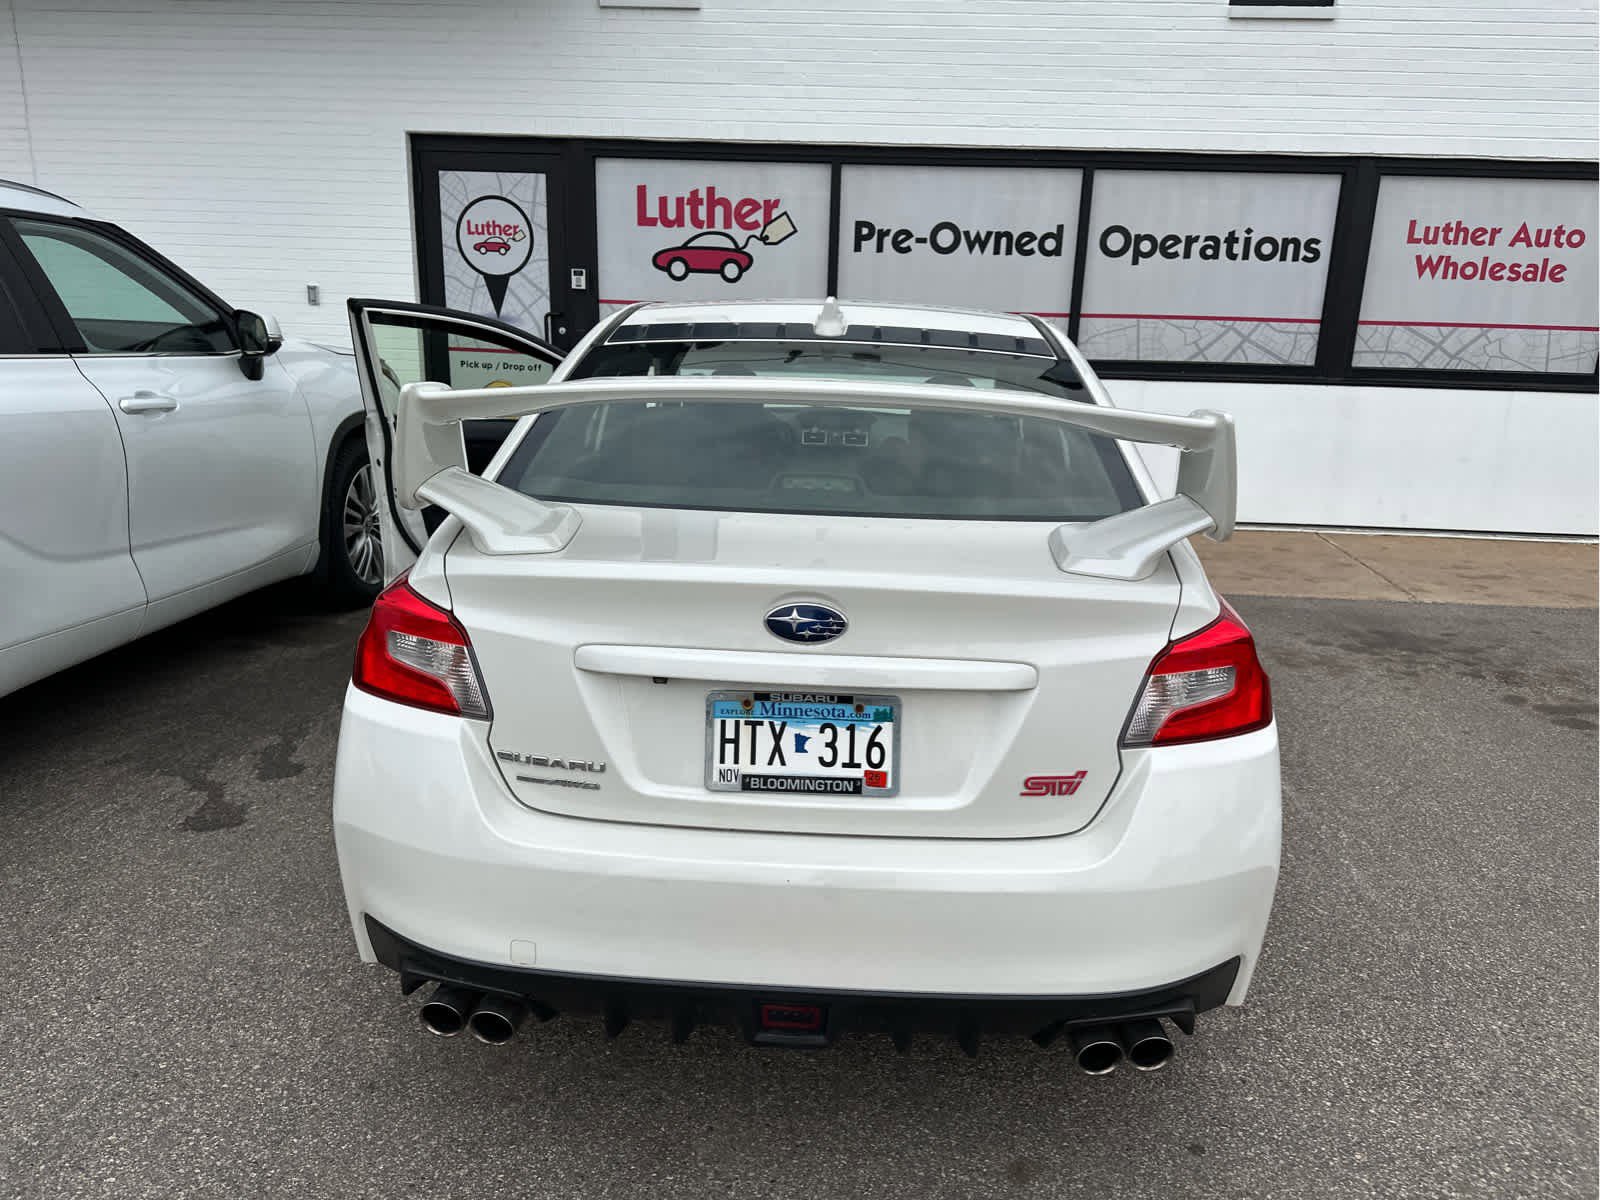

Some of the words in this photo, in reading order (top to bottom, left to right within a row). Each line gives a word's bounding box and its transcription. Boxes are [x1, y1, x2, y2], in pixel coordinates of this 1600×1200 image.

[636, 184, 782, 230] Luther
[466, 219, 521, 238] Luther
[853, 220, 1065, 257] Pre-Owned
[1406, 219, 1503, 247] Luther
[1509, 221, 1586, 250] Auto
[1100, 224, 1322, 266] Operations
[1414, 254, 1567, 283] Wholesale
[460, 360, 480, 369] Pick
[481, 362, 493, 371] up
[502, 362, 525, 372] Drop
[527, 364, 542, 372] off
[769, 693, 838, 704] SUBARU
[719, 719, 788, 766] HTX
[817, 722, 886, 770] 316
[496, 751, 606, 773] SUBARU
[718, 768, 740, 783] NOV
[750, 778, 854, 792] BLOOMINGTON
